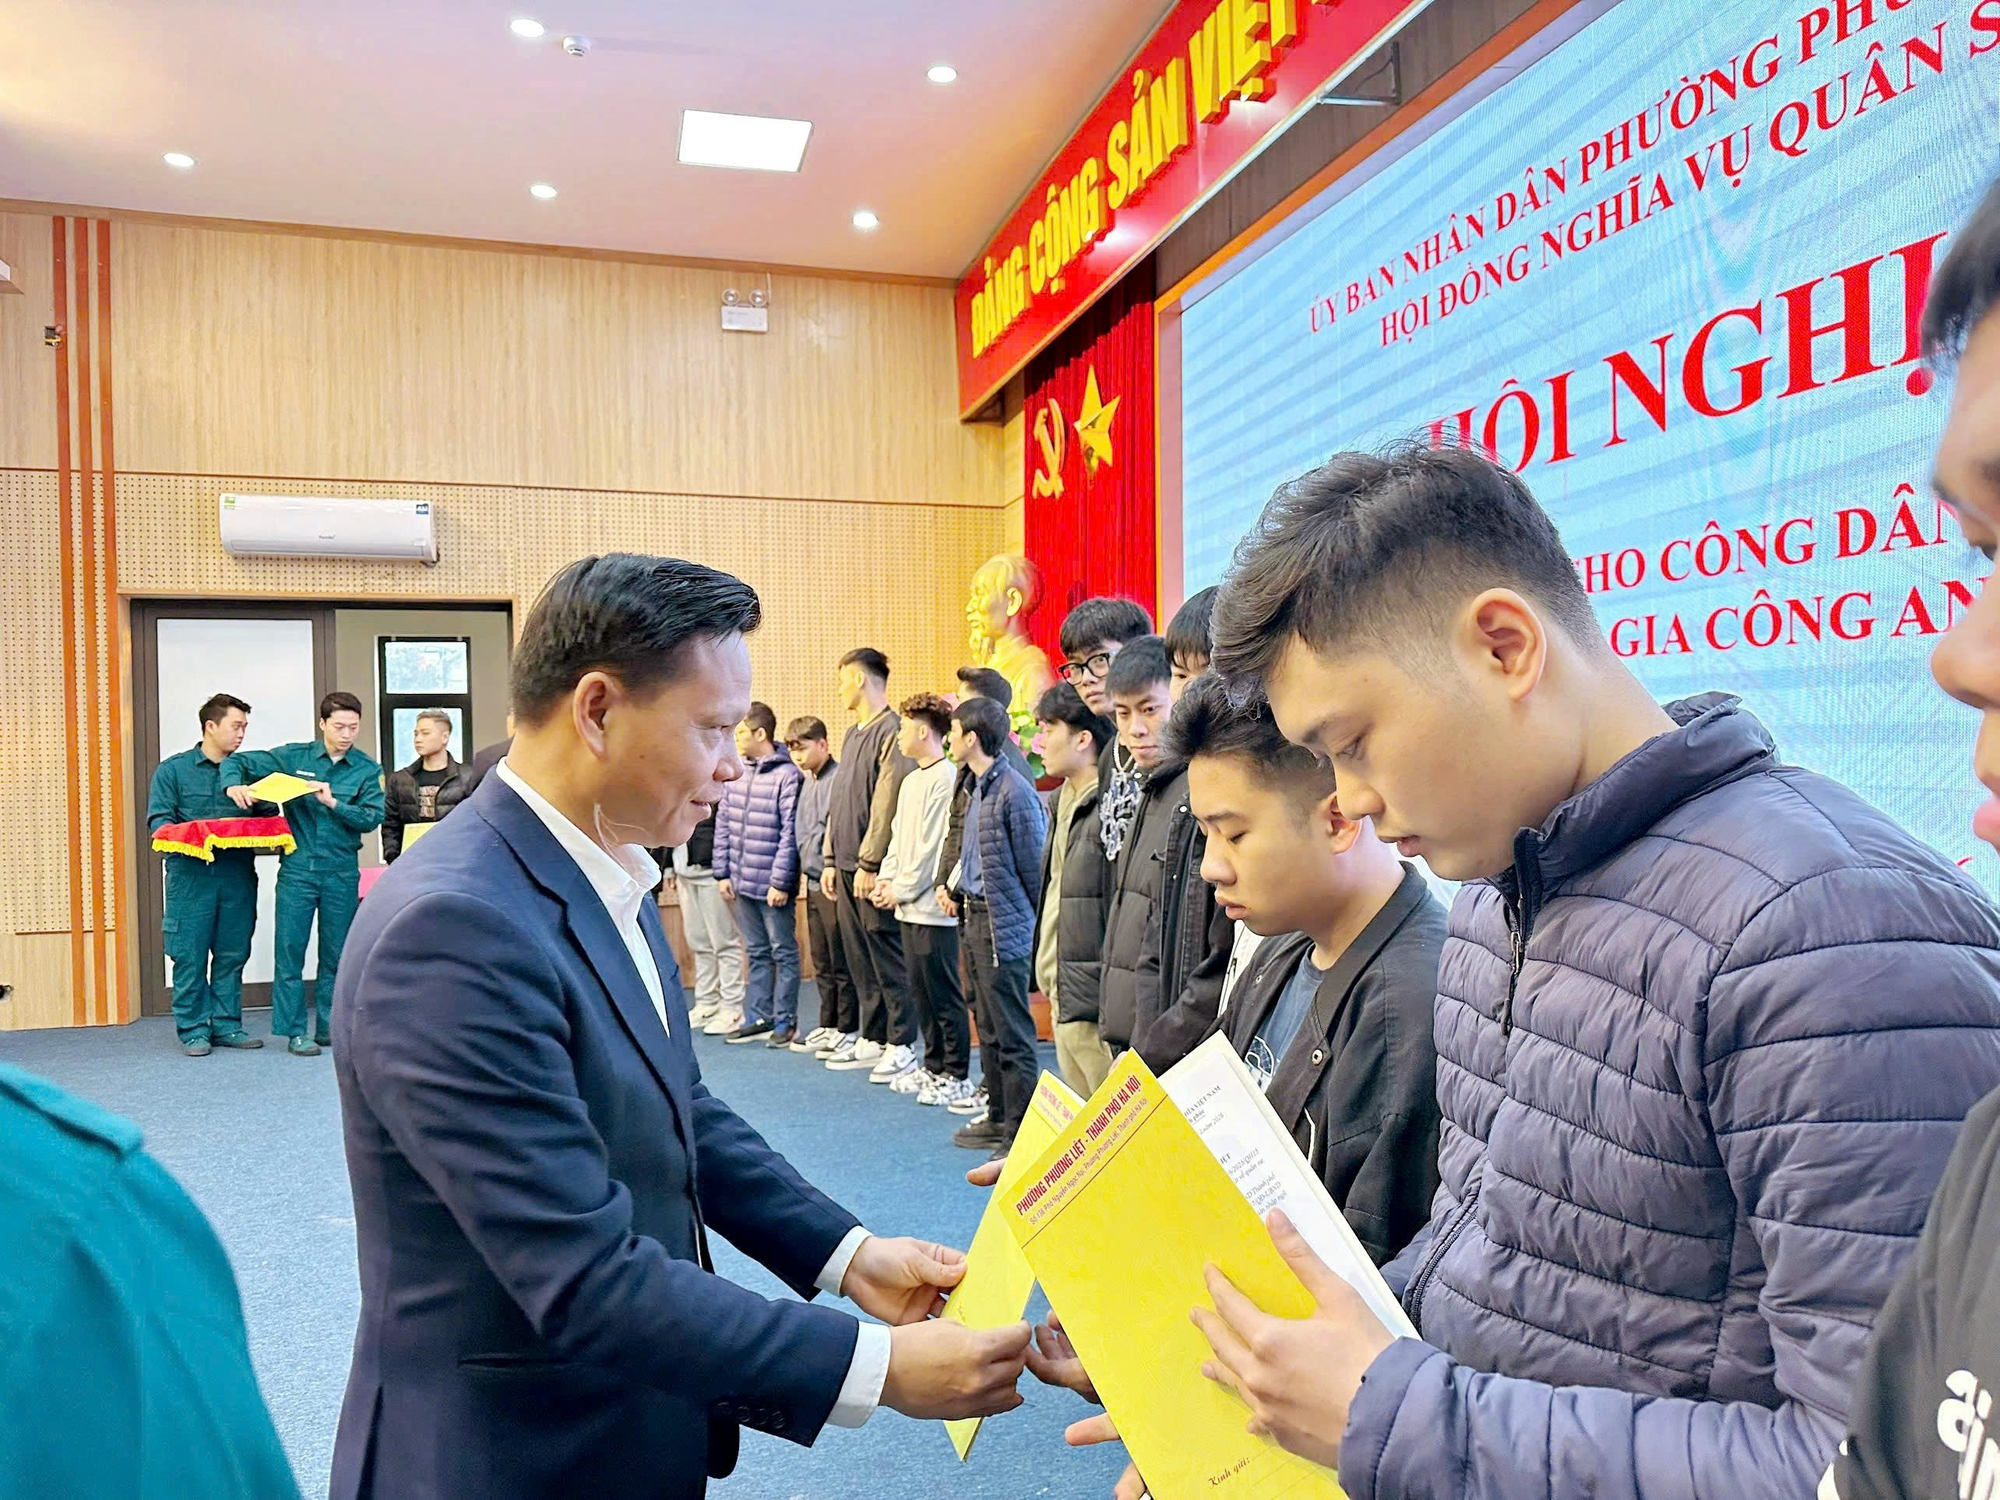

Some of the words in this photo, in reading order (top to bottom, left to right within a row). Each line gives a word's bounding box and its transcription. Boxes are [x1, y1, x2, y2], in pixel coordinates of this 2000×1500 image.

[971, 256, 1027, 359] ĐẢNG
[1029, 157, 1102, 295] CỘNG
[1107, 57, 1187, 209] SẢN
[1309, 295, 1340, 333] ỦY
[1345, 258, 1397, 316] BAN
[1402, 205, 1488, 276] NHÂN
[1495, 160, 1569, 232] DÂN
[1578, 36, 1781, 188] PHƯỜNG
[1797, 0, 1912, 64] PH
[1379, 295, 1431, 347] HỘI
[1439, 246, 1531, 317] ĐỒNG
[1540, 172, 1675, 270] NGHĨA
[1683, 124, 1752, 192] VỤ
[1768, 21, 1947, 157] QUÂN
[1603, 232, 1949, 448] NGHỊ
[1573, 549, 1647, 596] HO
[1659, 518, 1817, 584] CÔNG
[1610, 610, 1692, 659] GIA
[1705, 588, 1876, 651] CÔNG
[1016, 1181, 1048, 1216] PHƯỜNG
[1043, 1153, 1074, 1188] PHƯƠNG
[1069, 1136, 1087, 1160] LIỆT
[1085, 1110, 1111, 1142] THÀNH
[1104, 1094, 1122, 1120] PHỐ
[1116, 1086, 1130, 1105] HÀ
[1124, 1074, 1142, 1094] NỘI
[1206, 1085, 1221, 1101] NAM
